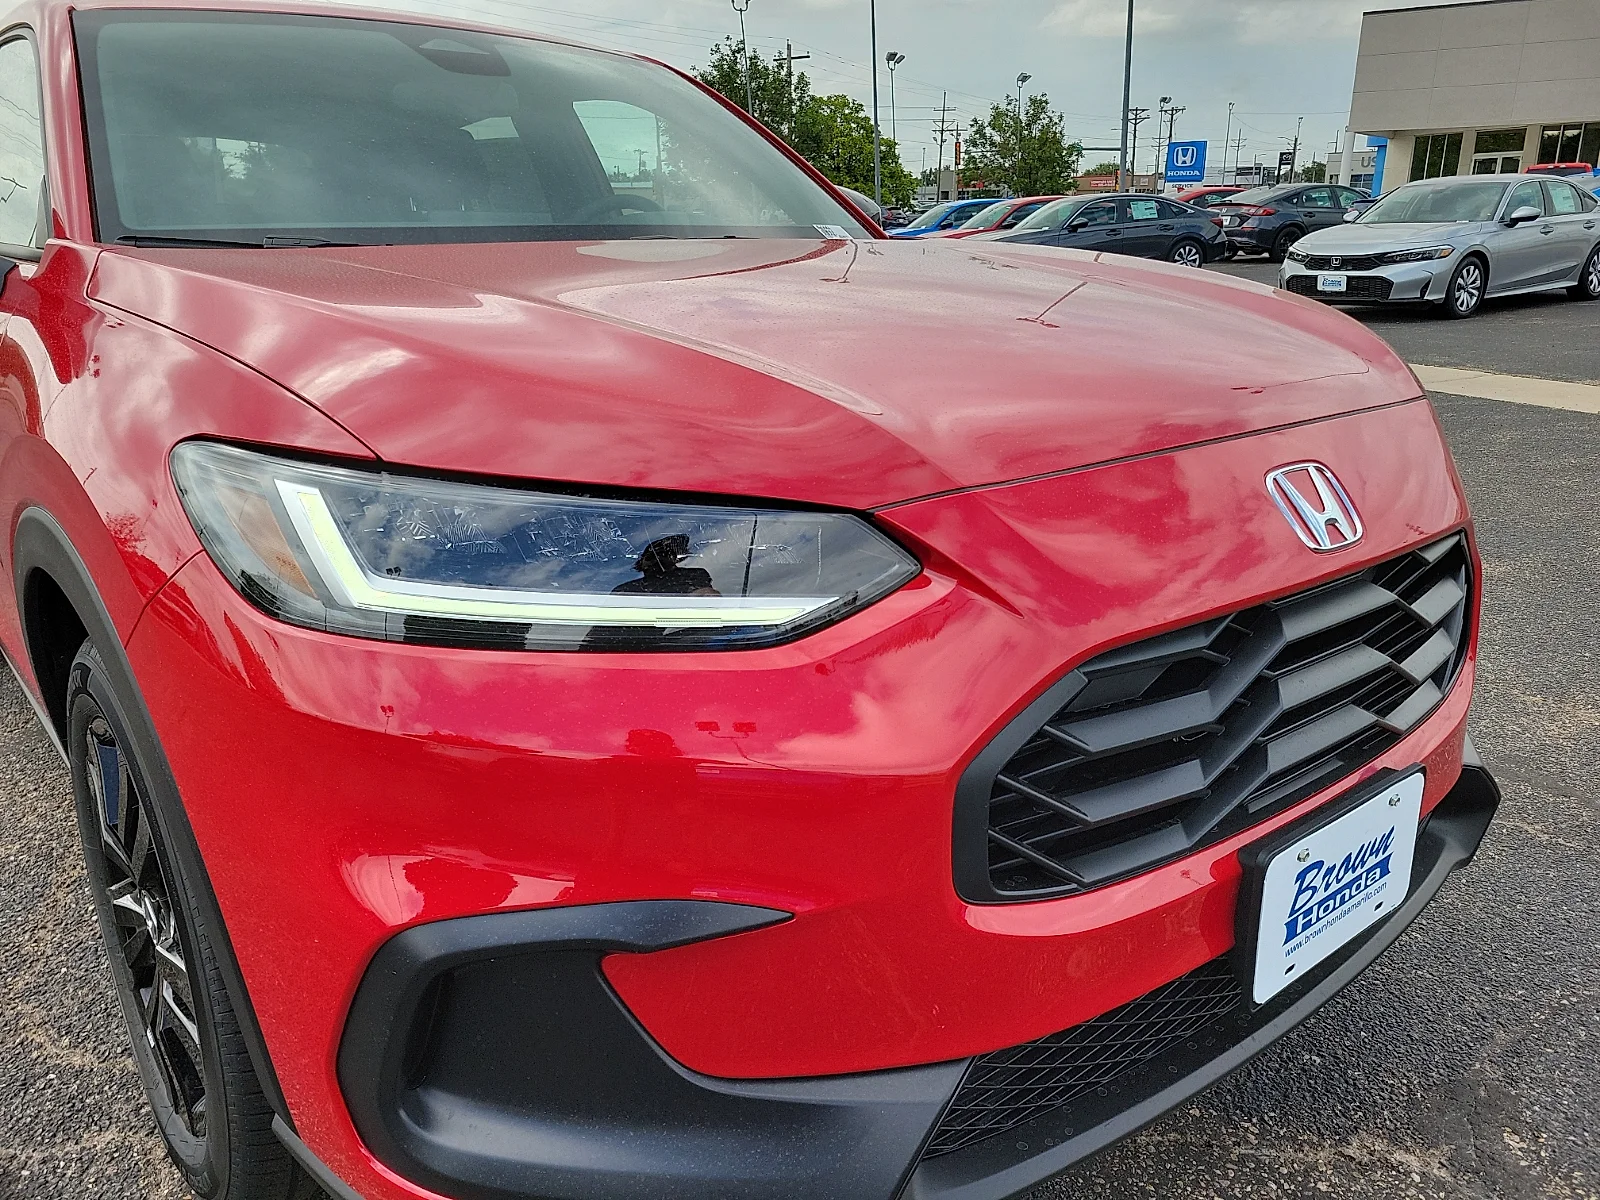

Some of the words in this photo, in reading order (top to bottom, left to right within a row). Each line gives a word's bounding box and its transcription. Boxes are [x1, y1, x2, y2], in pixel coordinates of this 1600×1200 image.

[1287, 825, 1395, 918] Brown
[1295, 866, 1382, 935] Honda
[1284, 881, 1388, 958] www.brownhondaamarillo.com
